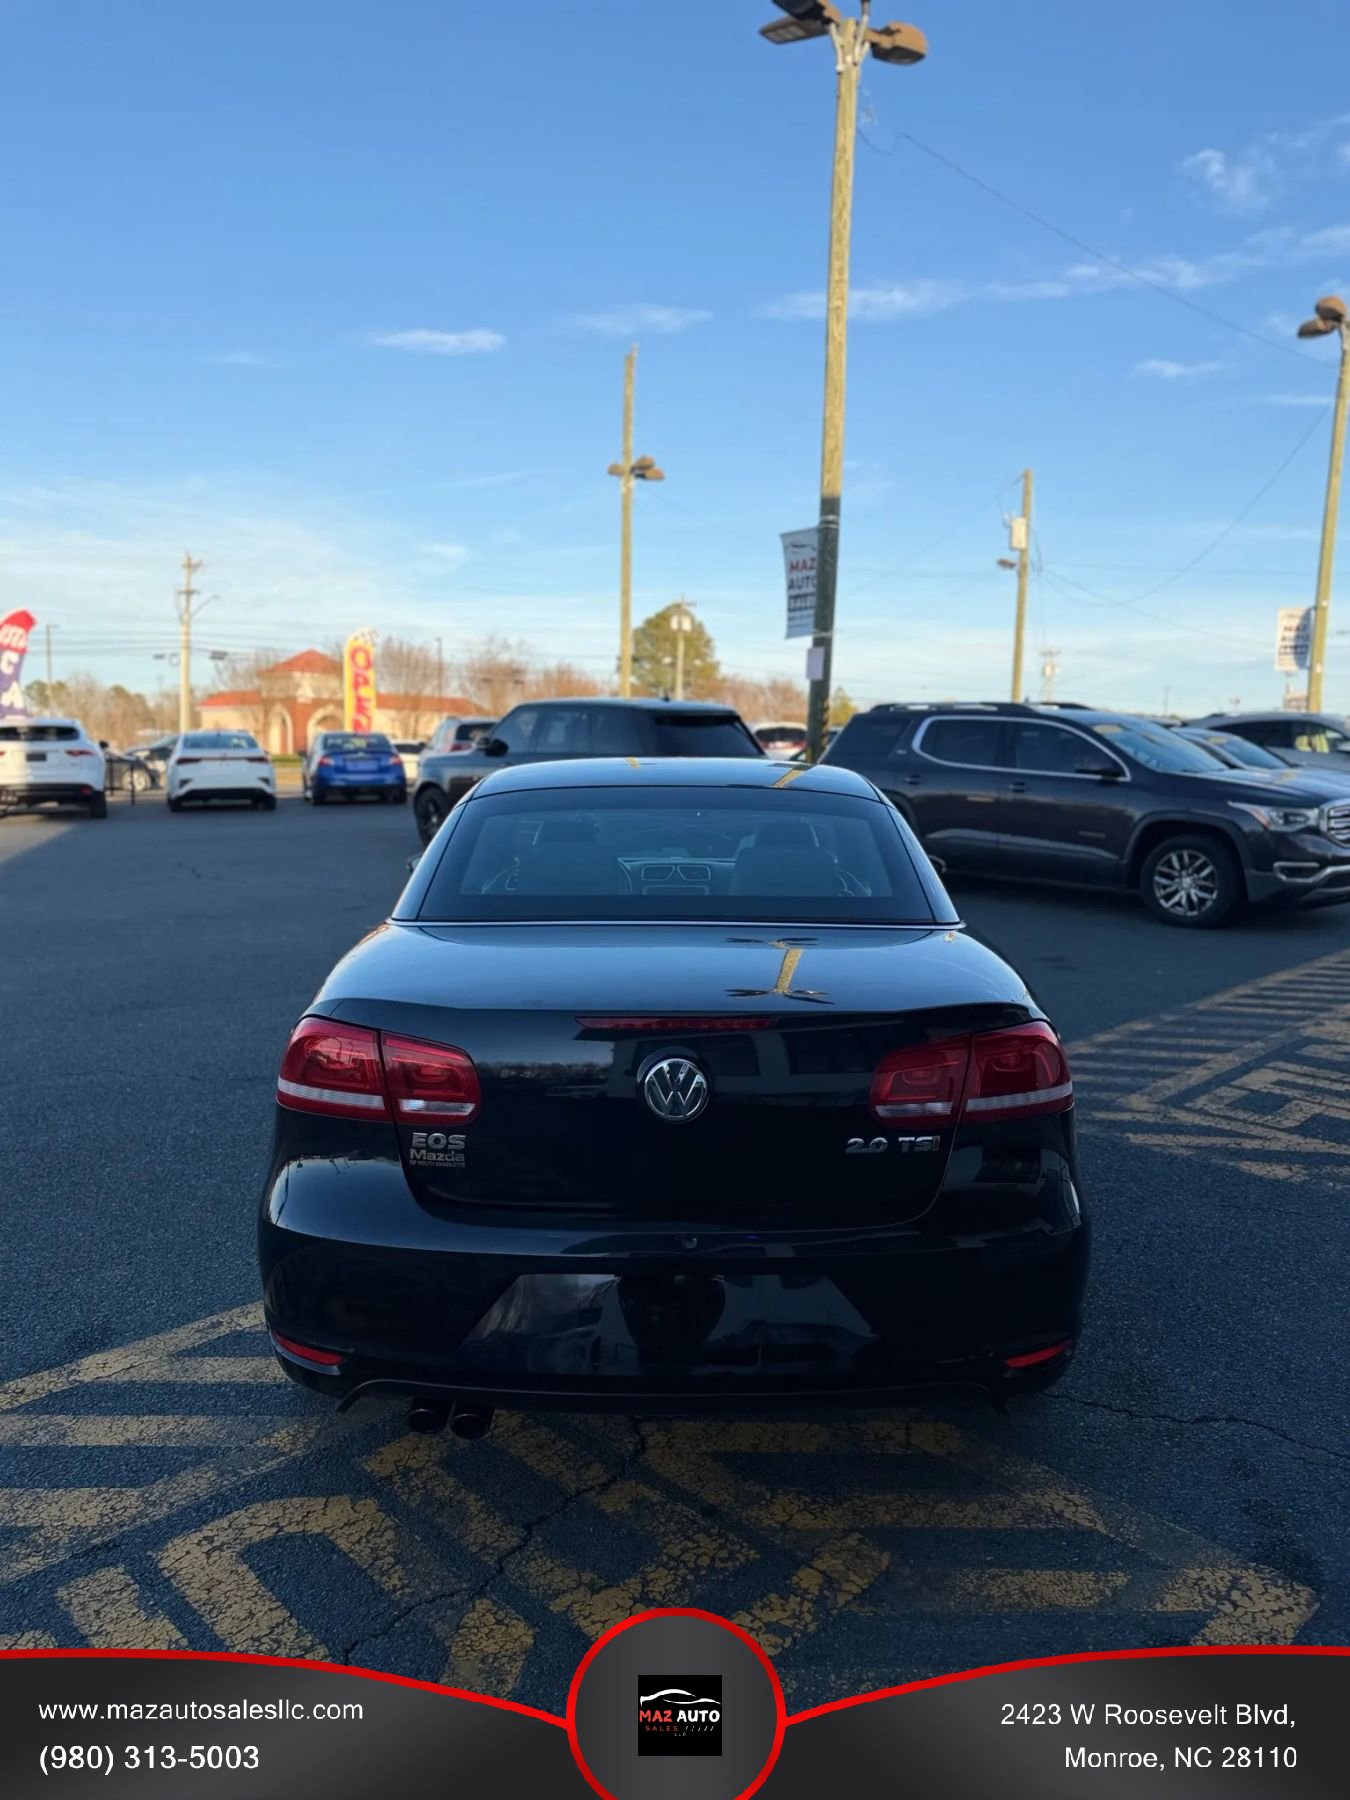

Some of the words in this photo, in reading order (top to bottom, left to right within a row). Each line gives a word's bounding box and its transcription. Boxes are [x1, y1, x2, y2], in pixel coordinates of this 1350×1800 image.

[789, 558, 817, 572] MAZ
[644, 1058, 707, 1120] VW
[411, 1132, 466, 1150] EOS
[409, 1148, 465, 1161] Mazda
